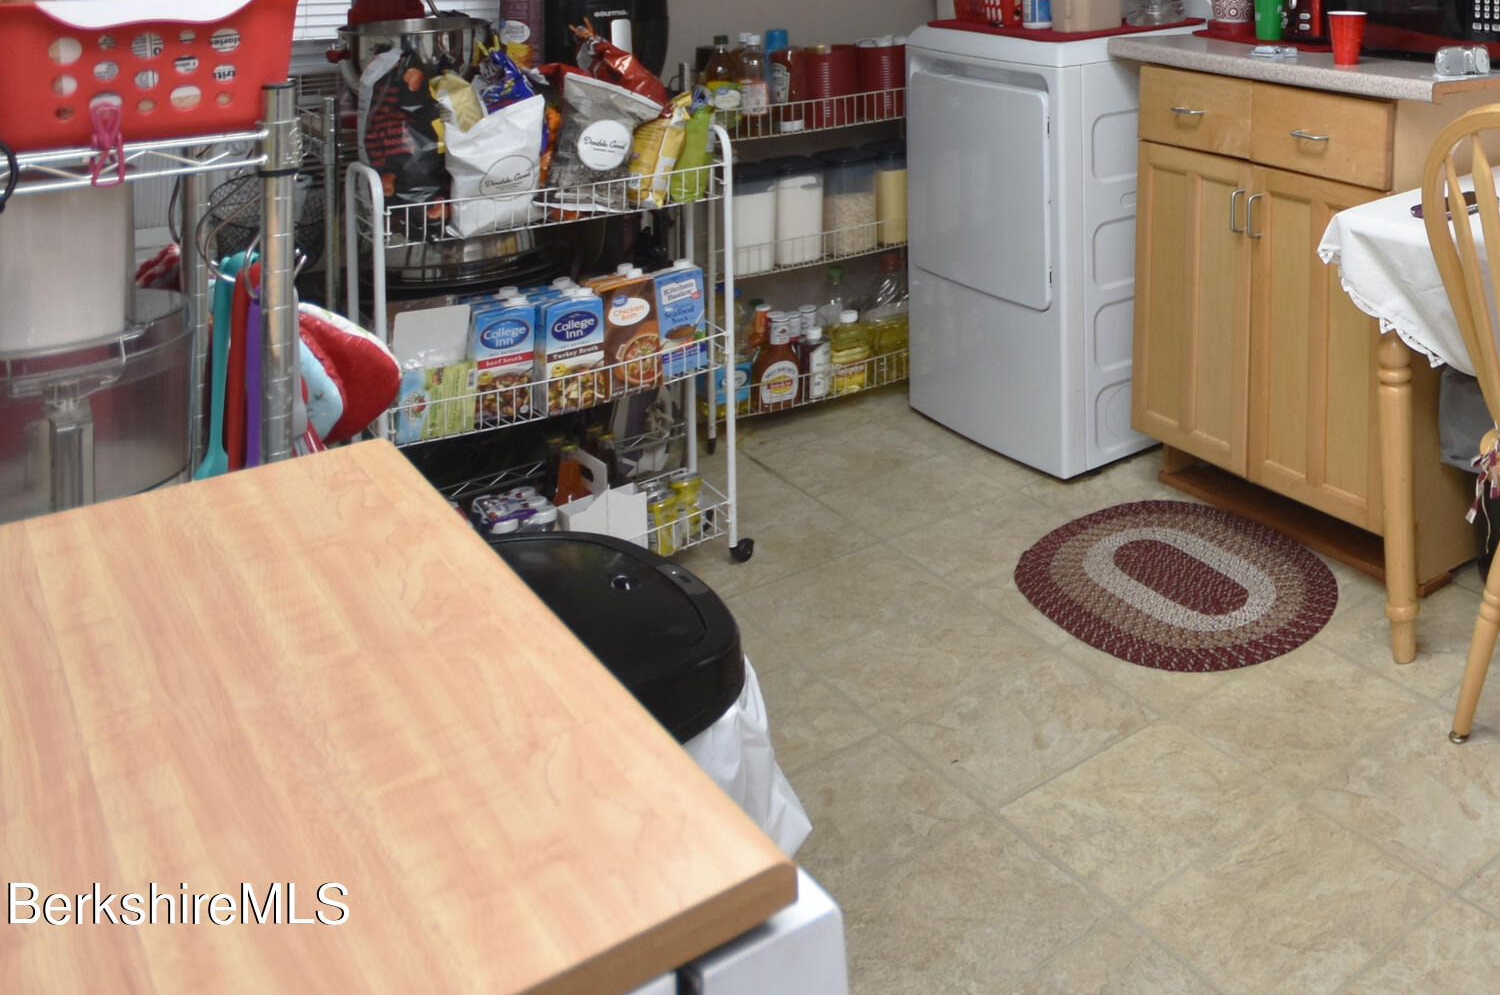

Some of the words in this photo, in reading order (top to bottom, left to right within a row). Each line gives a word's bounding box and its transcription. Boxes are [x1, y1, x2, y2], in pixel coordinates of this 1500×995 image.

[584, 136, 607, 146] Double
[554, 317, 595, 333] College
[483, 326, 527, 340] College
[566, 329, 584, 339] Inn
[495, 336, 514, 347] Inn
[552, 350, 578, 361] Turkey
